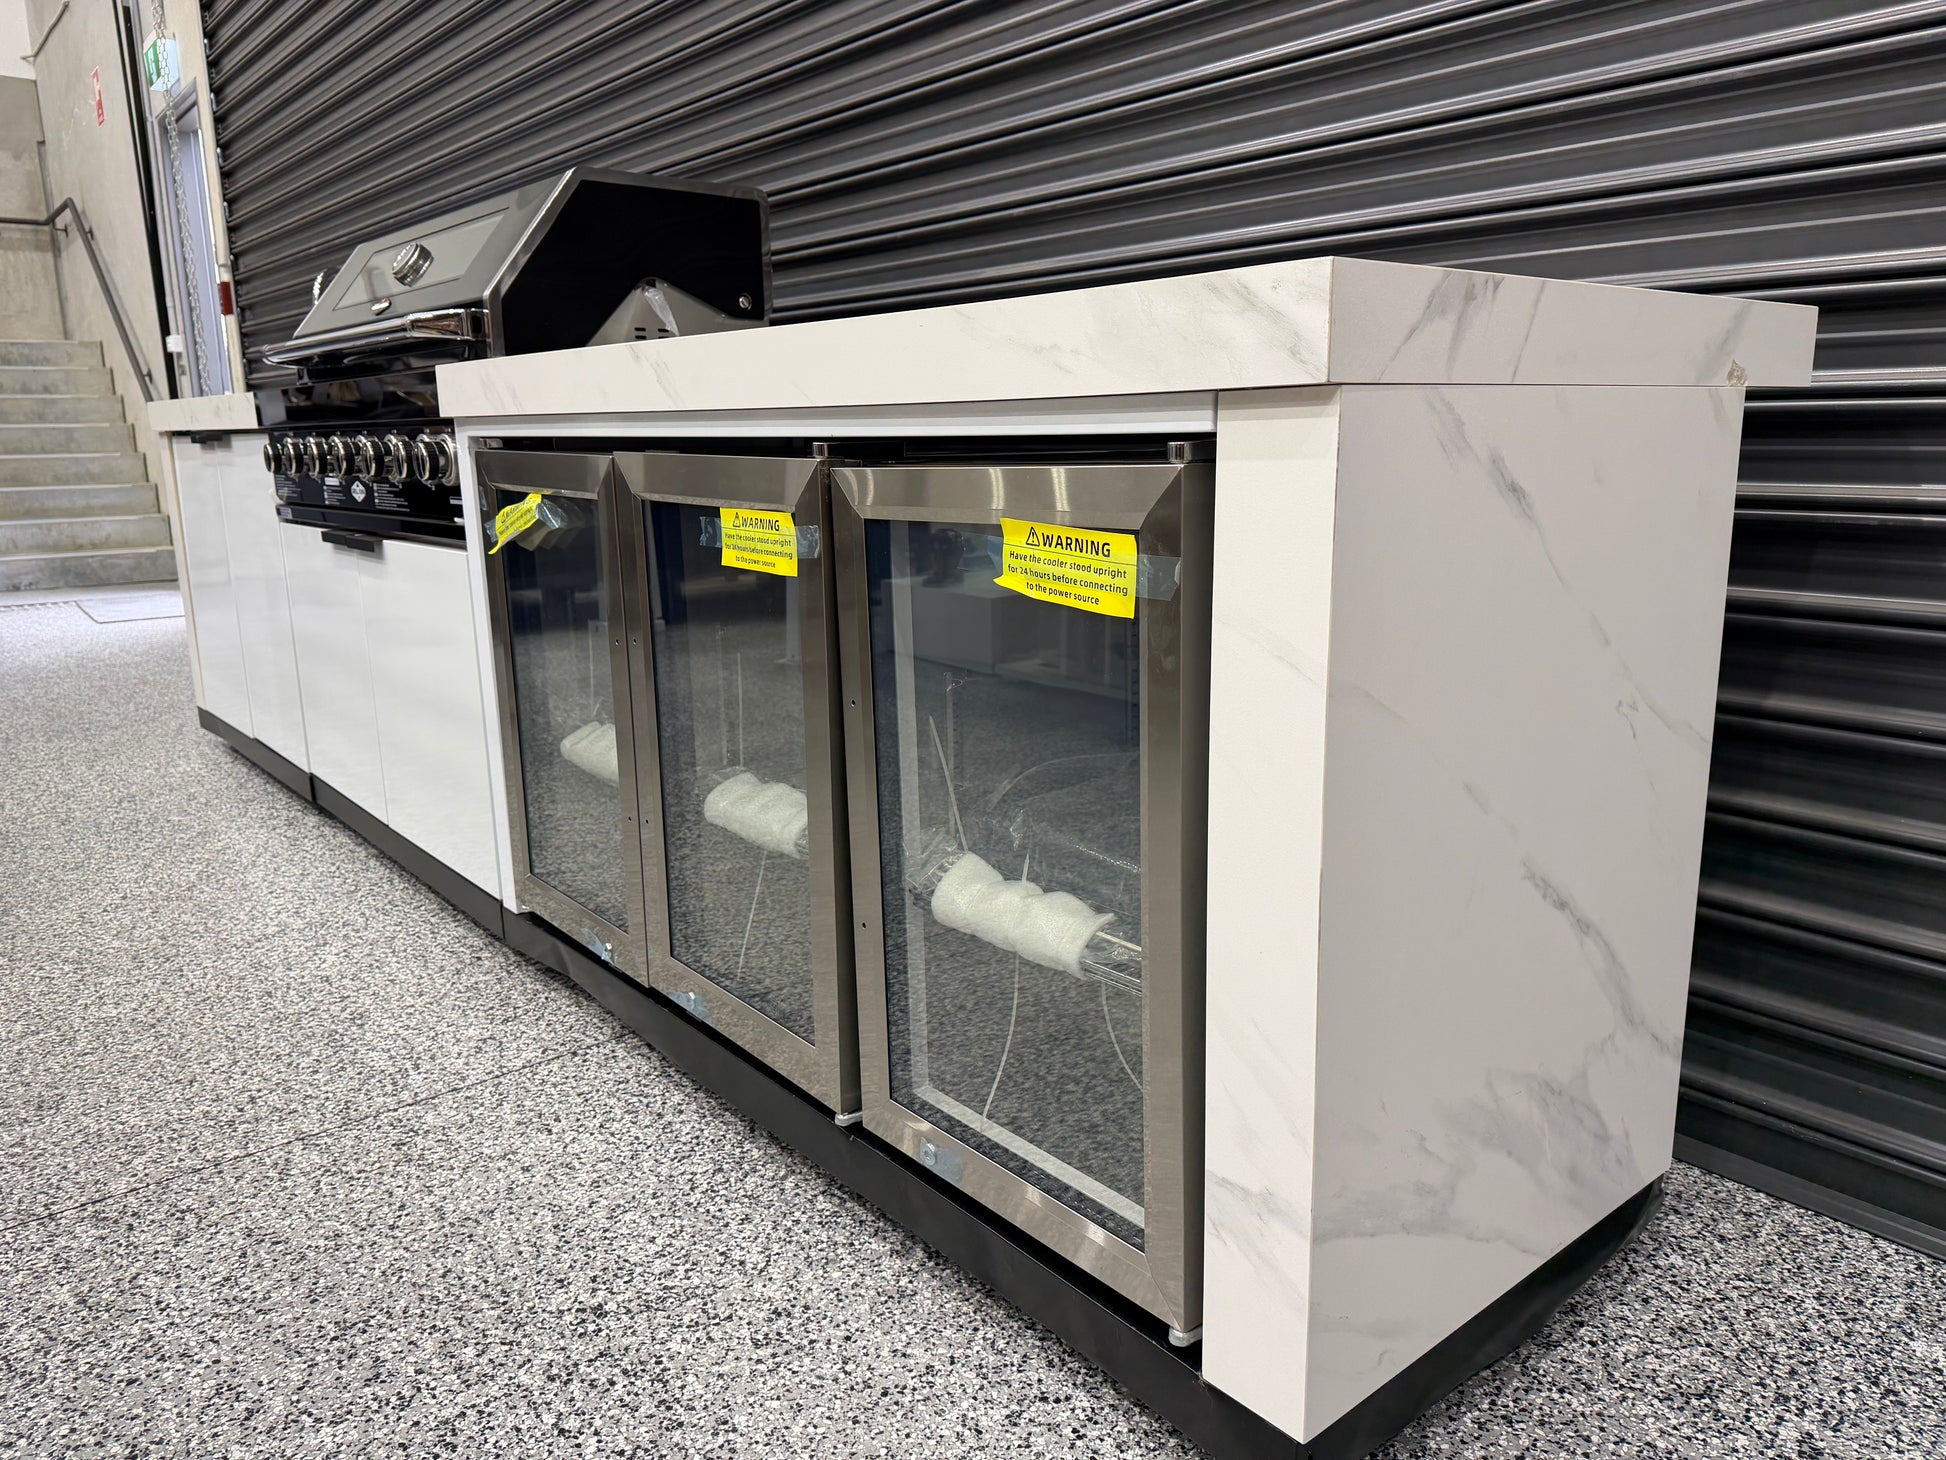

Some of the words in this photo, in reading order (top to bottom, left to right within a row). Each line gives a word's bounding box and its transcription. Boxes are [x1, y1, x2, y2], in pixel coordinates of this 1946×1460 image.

[742, 516, 780, 531] WARNING
[764, 549, 792, 560] connecting
[770, 538, 791, 548] upright
[1042, 532, 1111, 558] WARNING
[1010, 550, 1027, 562] Have
[1029, 554, 1041, 564] the
[1043, 556, 1068, 568] cooler
[1069, 562, 1092, 572] stood
[1094, 566, 1127, 579] upright
[1008, 564, 1018, 573] for
[1020, 567, 1028, 575] 24
[1030, 568, 1050, 580] hours
[1052, 572, 1078, 586] before
[1080, 578, 1128, 596] connecting
[1026, 582, 1034, 590] to
[1035, 584, 1047, 593] the
[1049, 587, 1072, 598] power
[1074, 592, 1100, 605] source
